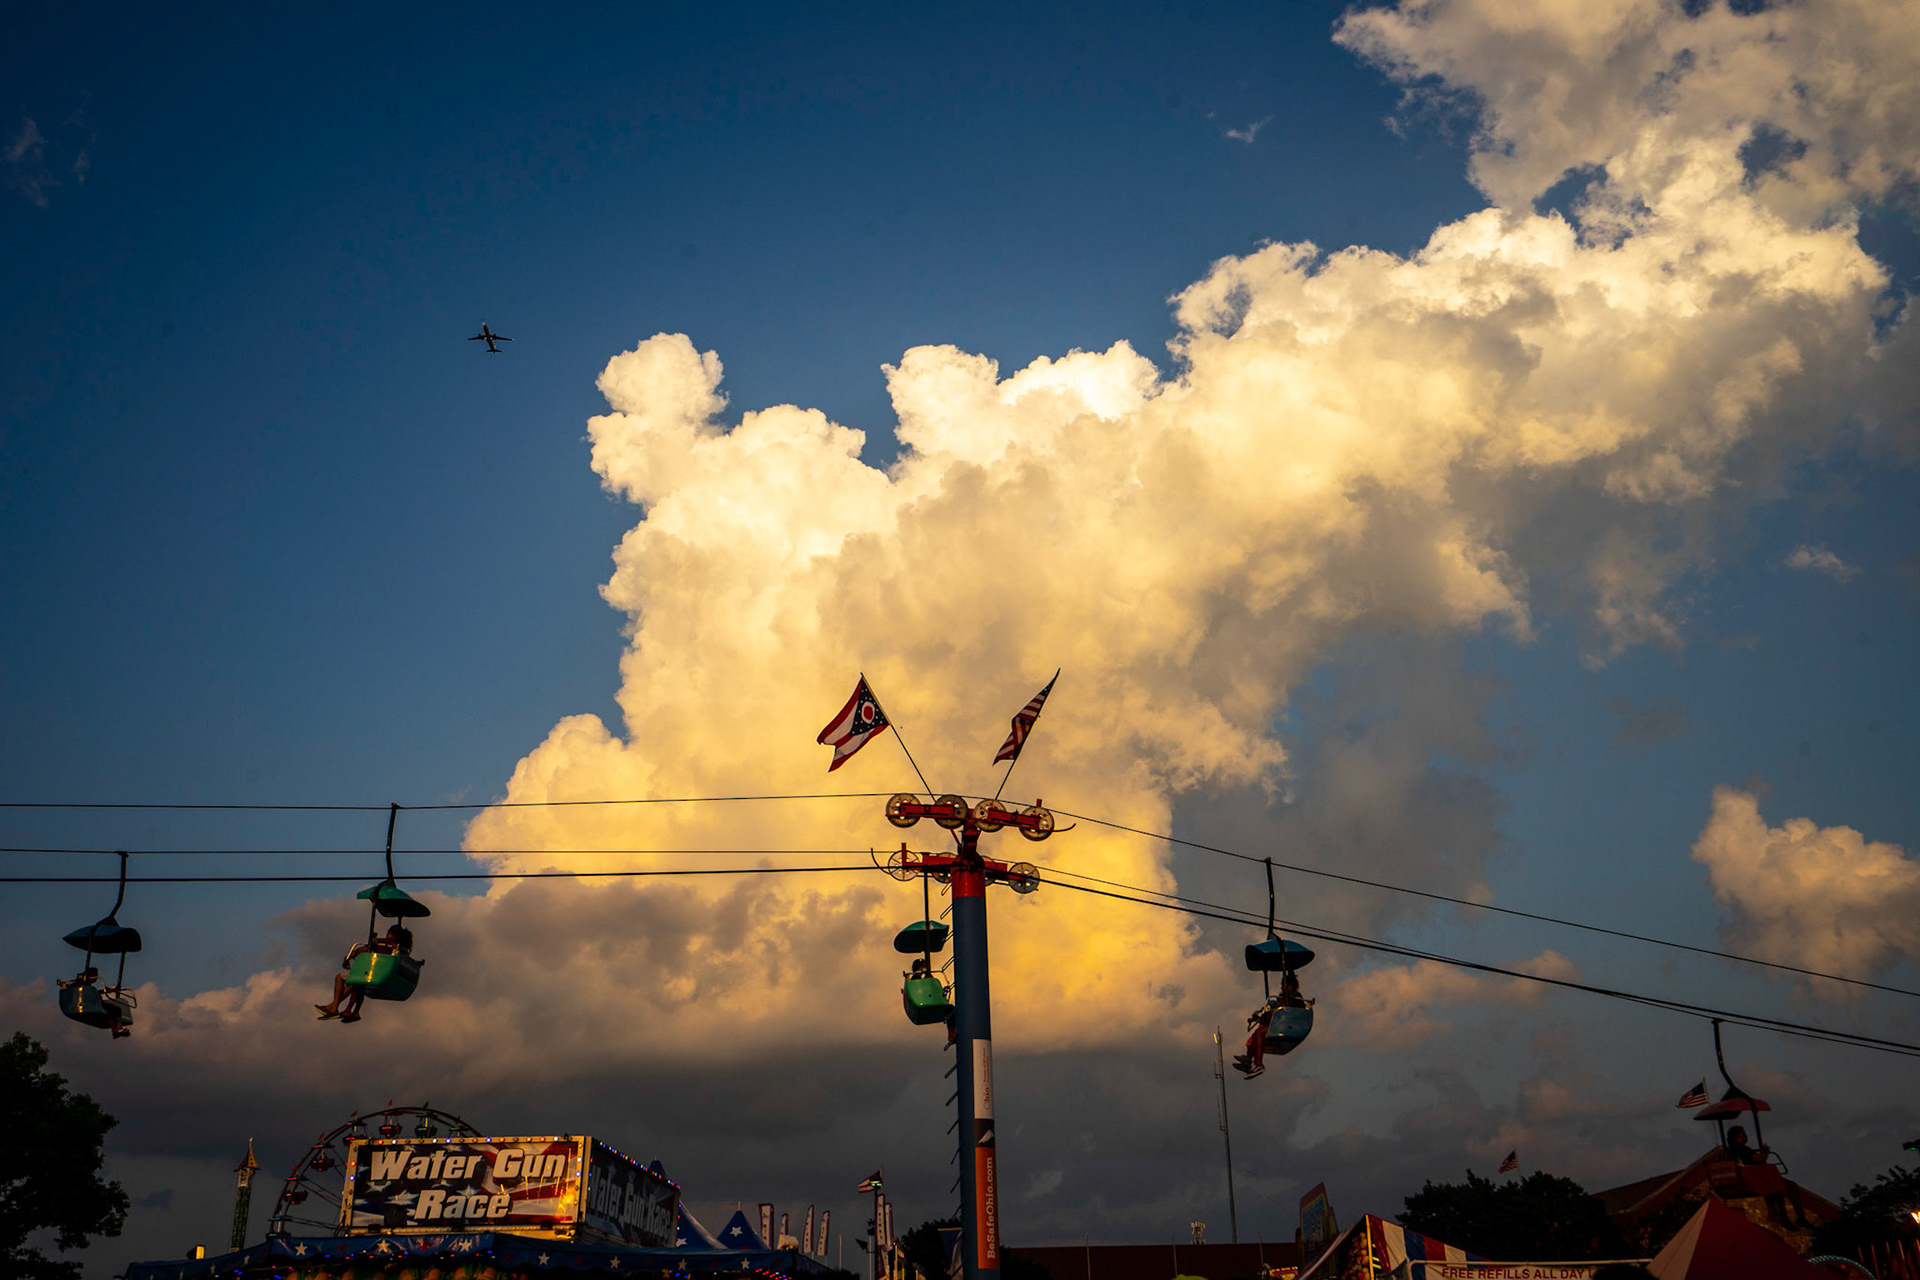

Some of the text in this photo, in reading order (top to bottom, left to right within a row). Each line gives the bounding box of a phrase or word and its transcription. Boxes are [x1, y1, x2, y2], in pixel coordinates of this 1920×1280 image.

[370, 1148, 567, 1180] Water Gun
[413, 1189, 511, 1221] Race
[623, 1181, 645, 1228] Gun
[646, 1192, 671, 1239] Race
[986, 1157, 997, 1260] BeSafeOhio.com
[1441, 1267, 1475, 1280] FREE
[1478, 1268, 1529, 1280] REFILLS
[1533, 1268, 1557, 1280] ALL
[1560, 1268, 1585, 1280] DAY
